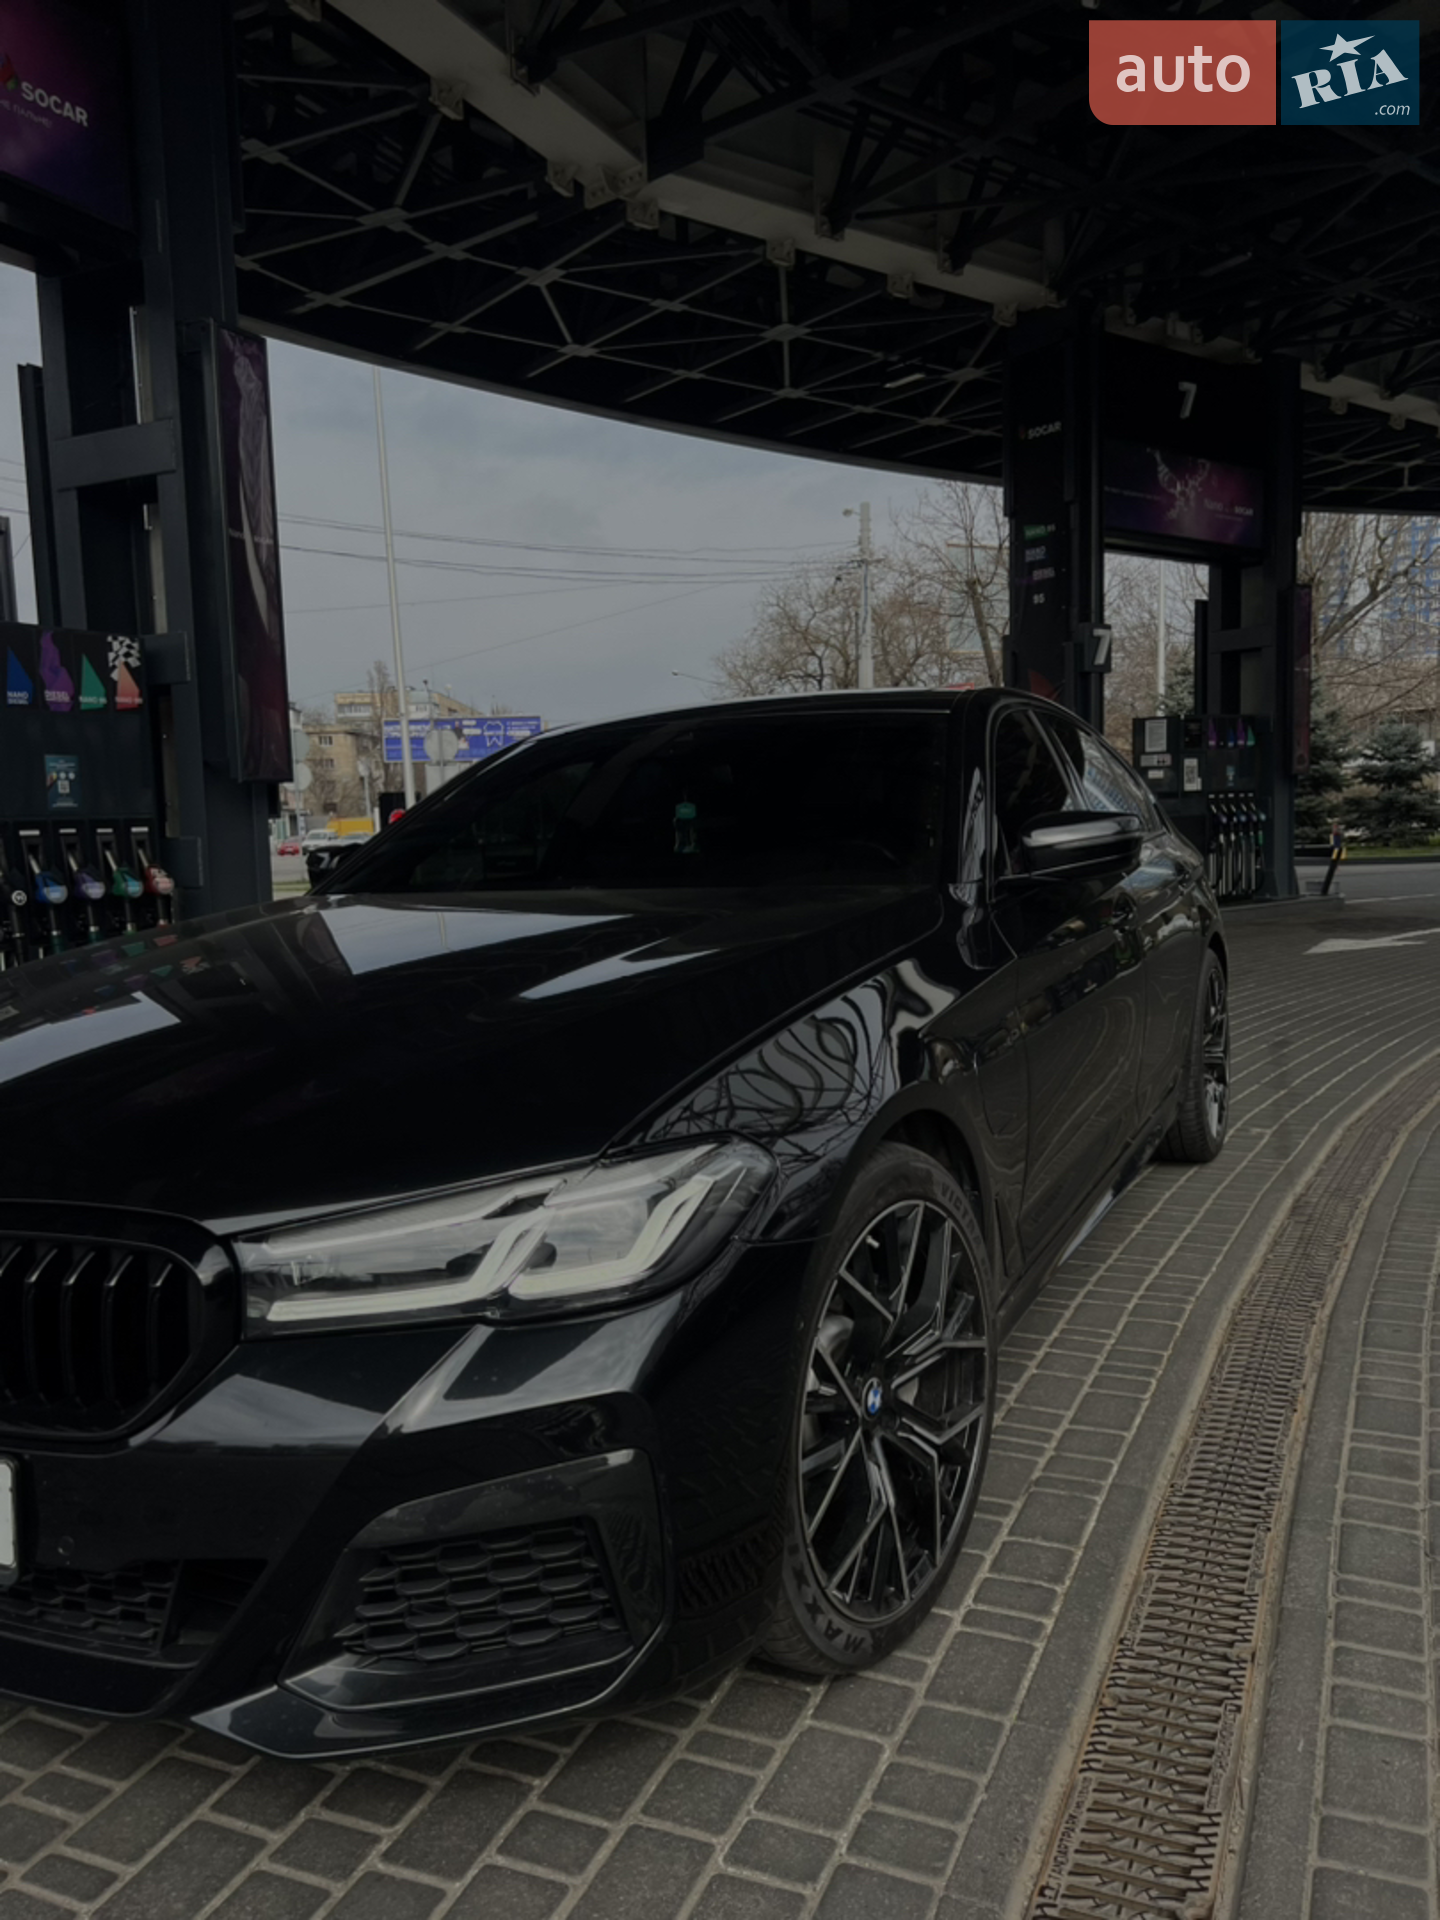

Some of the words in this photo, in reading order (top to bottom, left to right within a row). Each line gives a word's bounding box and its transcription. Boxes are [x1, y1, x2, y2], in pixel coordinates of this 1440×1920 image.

[21, 81, 89, 128] SOCAR
[1178, 380, 1198, 420] 7
[1027, 421, 1063, 440] SOCAR
[1092, 628, 1112, 666] 7
